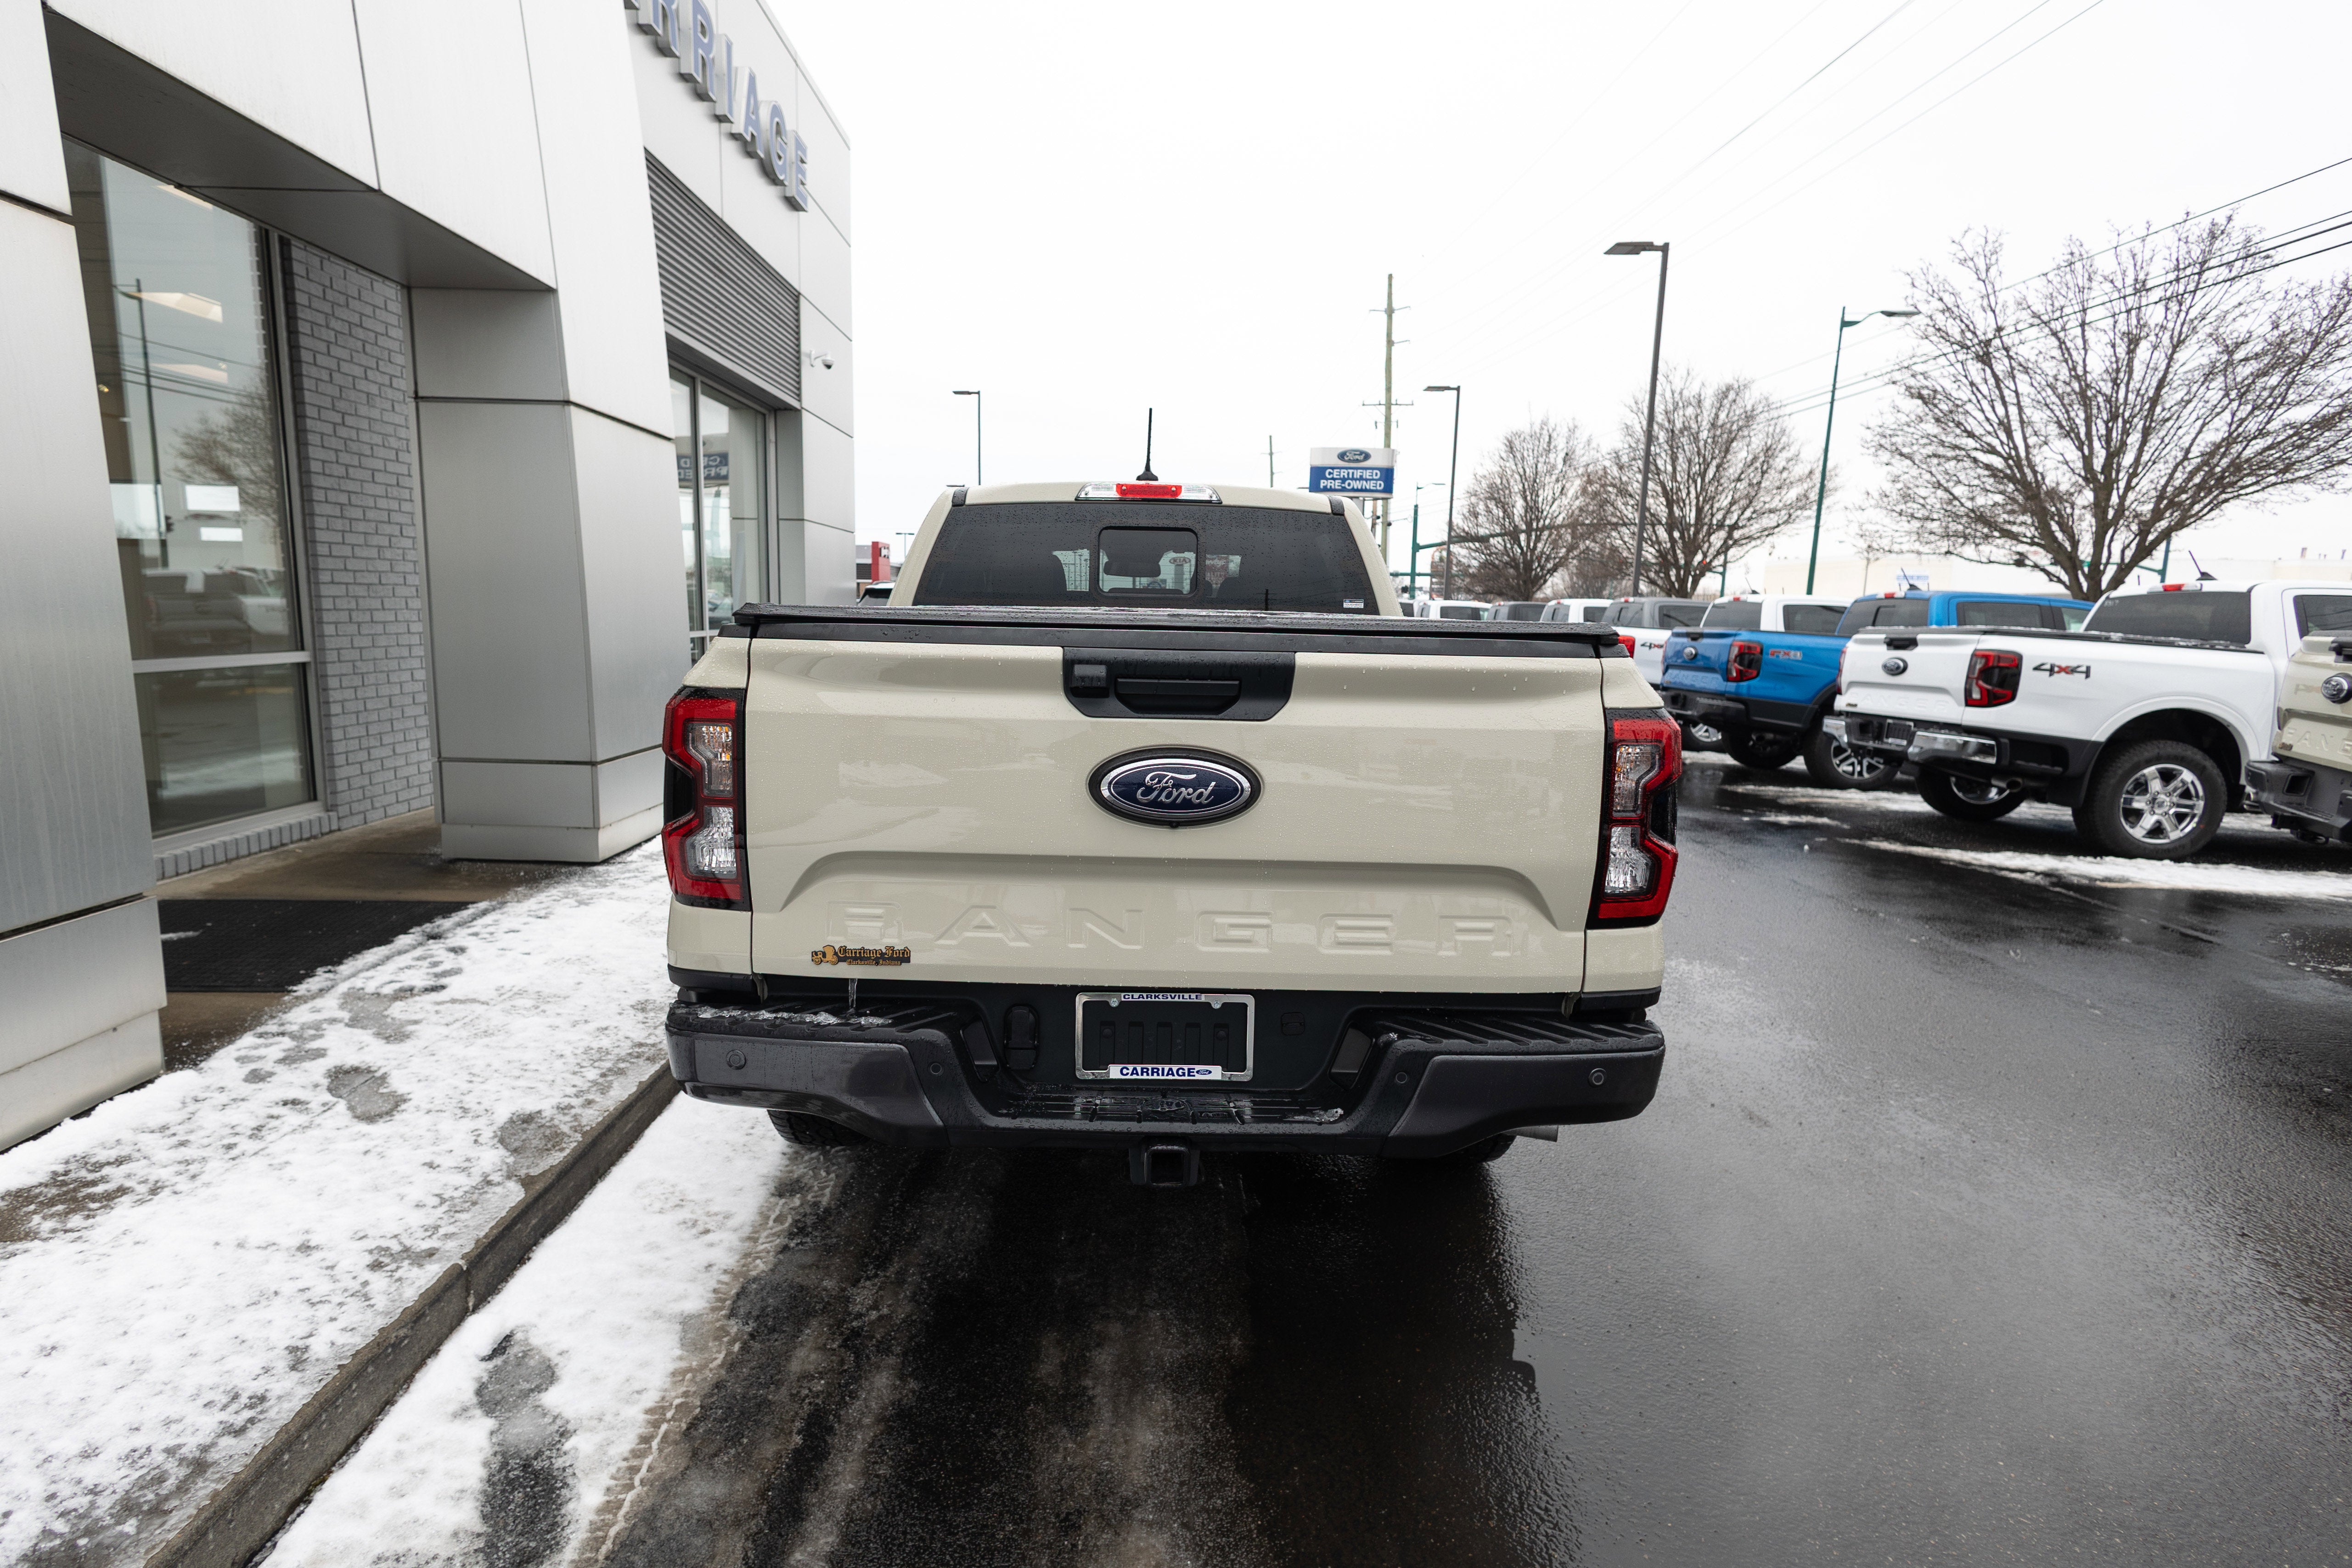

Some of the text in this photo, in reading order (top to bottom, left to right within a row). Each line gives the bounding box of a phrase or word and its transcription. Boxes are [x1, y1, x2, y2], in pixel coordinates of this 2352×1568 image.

[1344, 450, 1365, 461] Ford
[1325, 469, 1380, 478] CERTIFIED
[1320, 480, 1384, 490] PRE-OWNED
[1769, 649, 1802, 660] FX4
[1137, 771, 1215, 805] Ford
[825, 899, 1514, 957] RANGER
[838, 946, 911, 959] Carriage Ford
[1120, 1067, 1196, 1077] CARRIAGE
